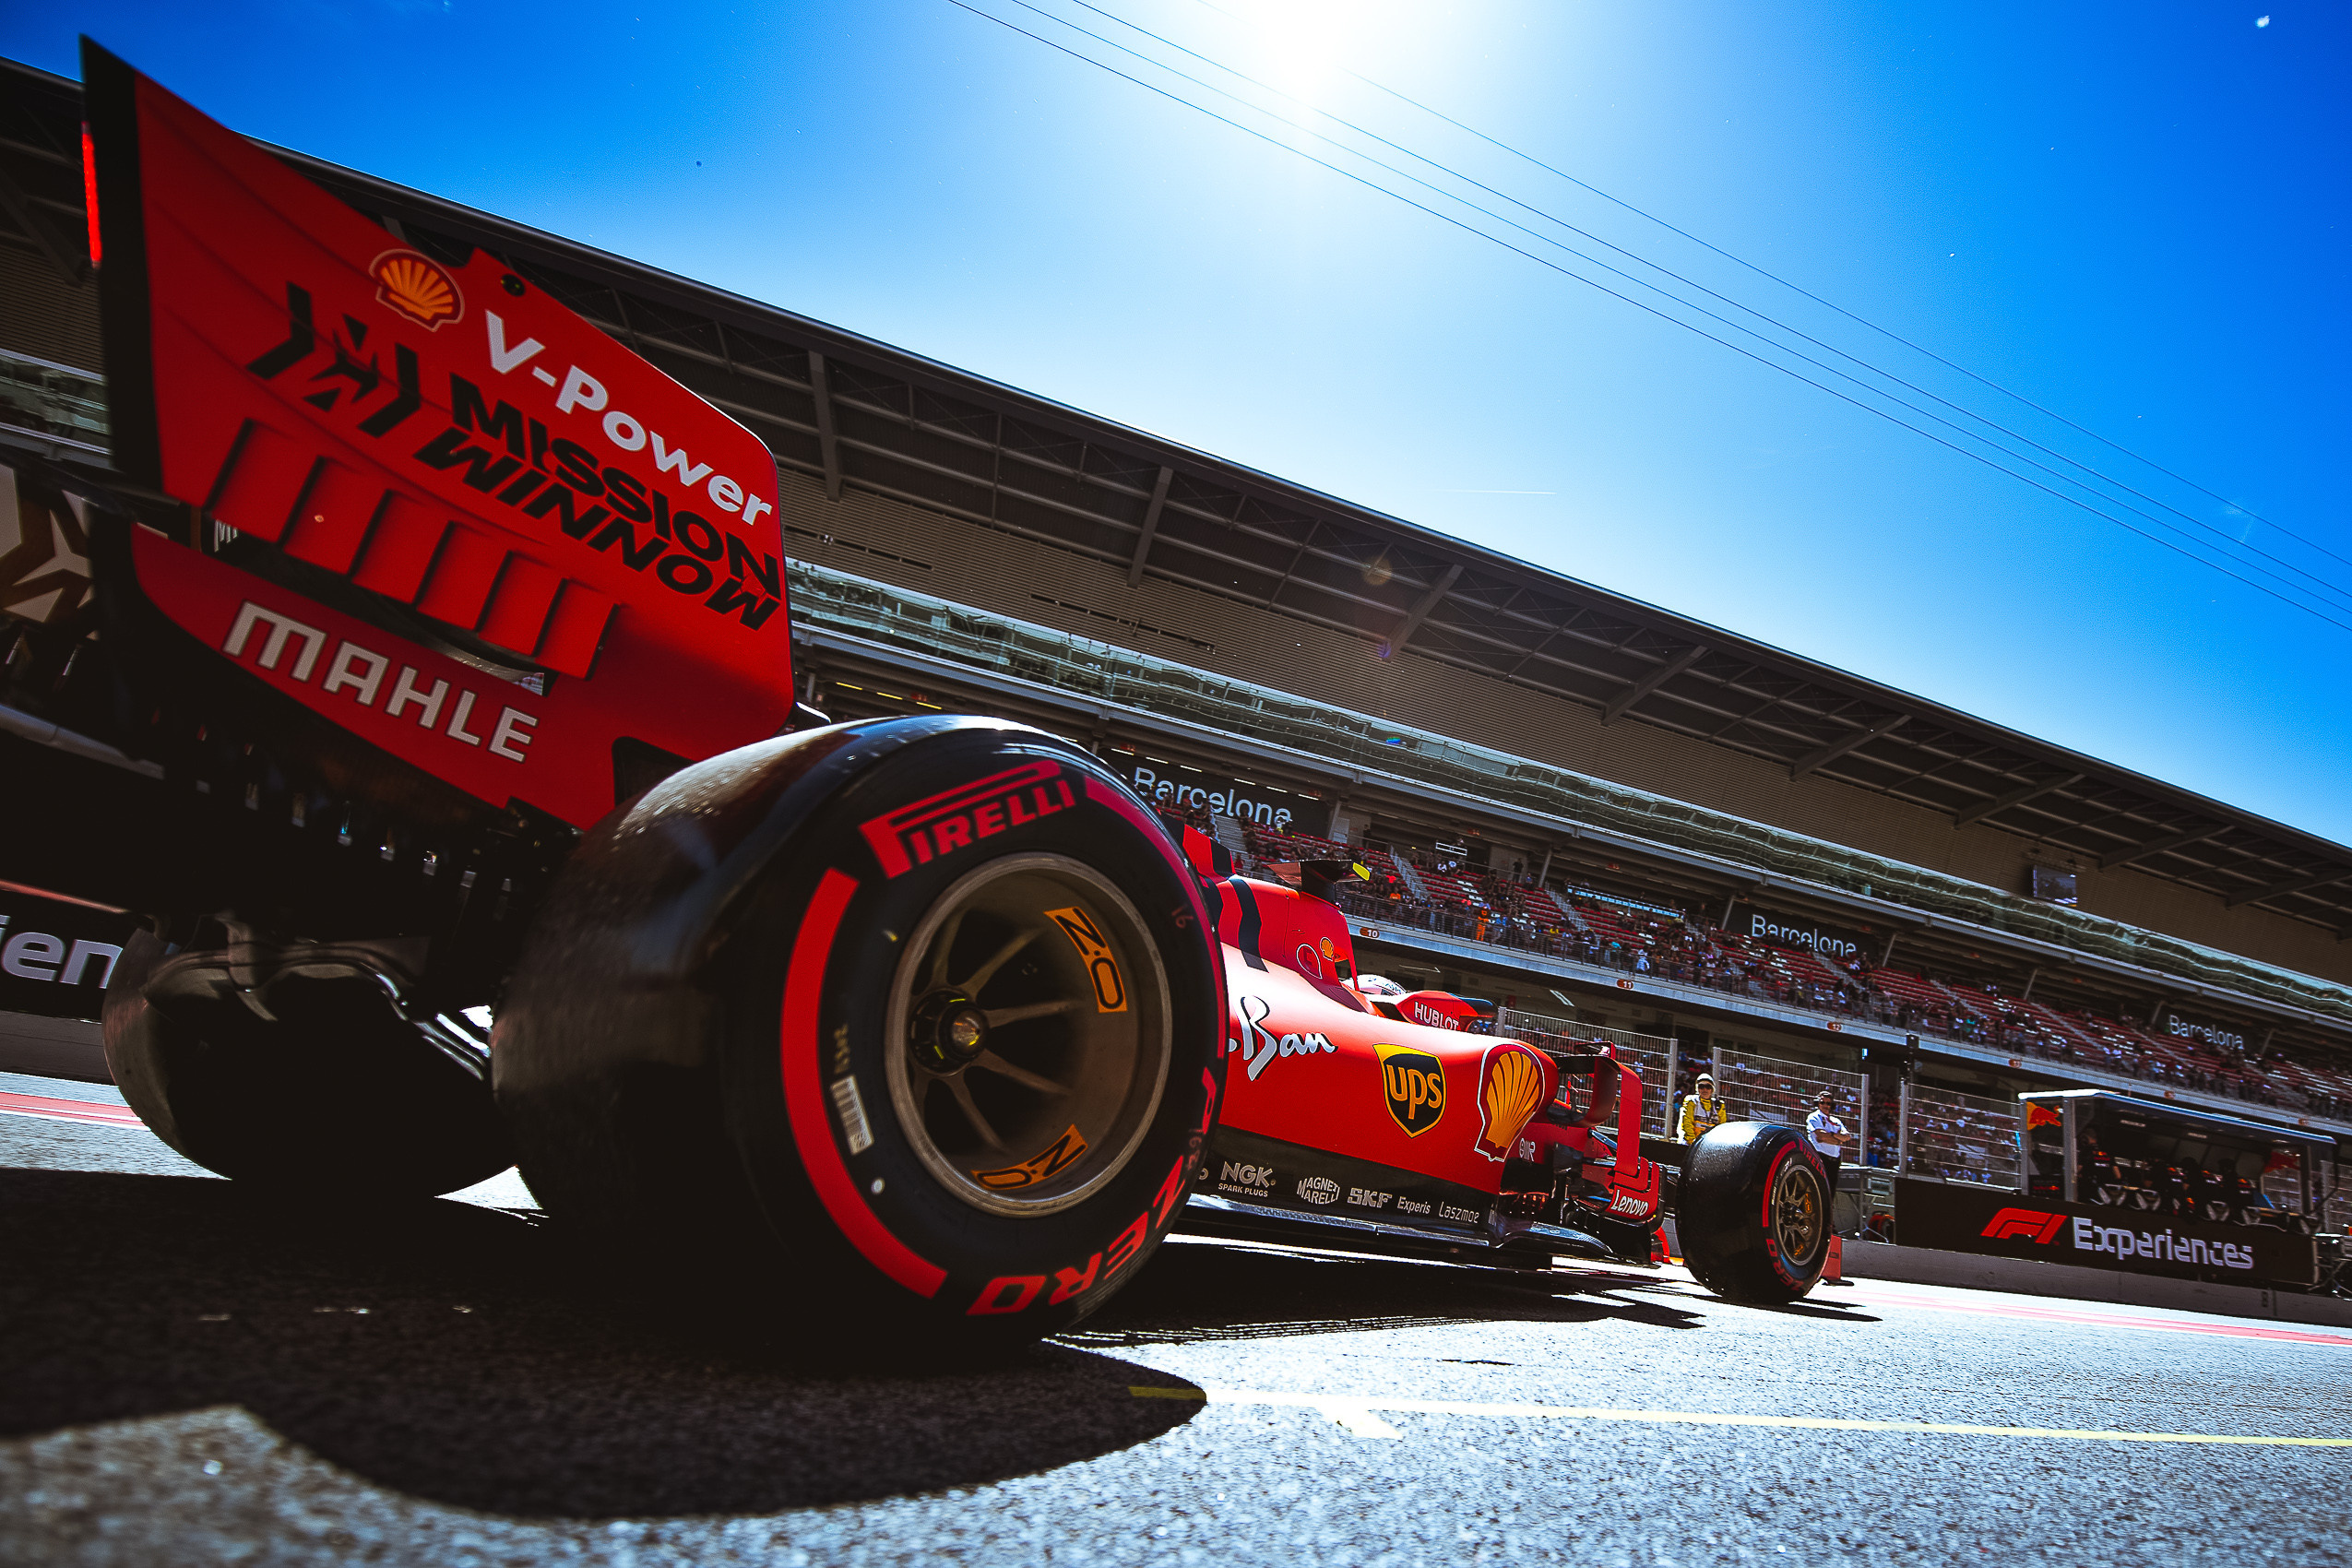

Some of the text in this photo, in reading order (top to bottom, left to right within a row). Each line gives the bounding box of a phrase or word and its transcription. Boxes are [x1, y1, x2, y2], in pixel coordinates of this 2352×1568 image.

[485, 309, 771, 526] V-Power
[449, 371, 781, 600] MISSION
[412, 426, 780, 632] WINNOW
[222, 600, 539, 763] MAHLE
[859, 760, 1076, 879] PIRELLI
[1134, 766, 1292, 828] Barcelona
[1367, 929, 1378, 938] 10
[1414, 1001, 1459, 1031] HUBLOT
[1218, 1182, 1268, 1198] SPARK PLUGS
[1219, 1160, 1274, 1189] NGK
[1347, 1187, 1393, 1208] SKF
[1396, 1195, 1431, 1215] Experis
[1610, 1189, 1649, 1217] Lenovo
[966, 1155, 1186, 1316] ZERO
[2073, 1216, 2256, 1269] Experiences
